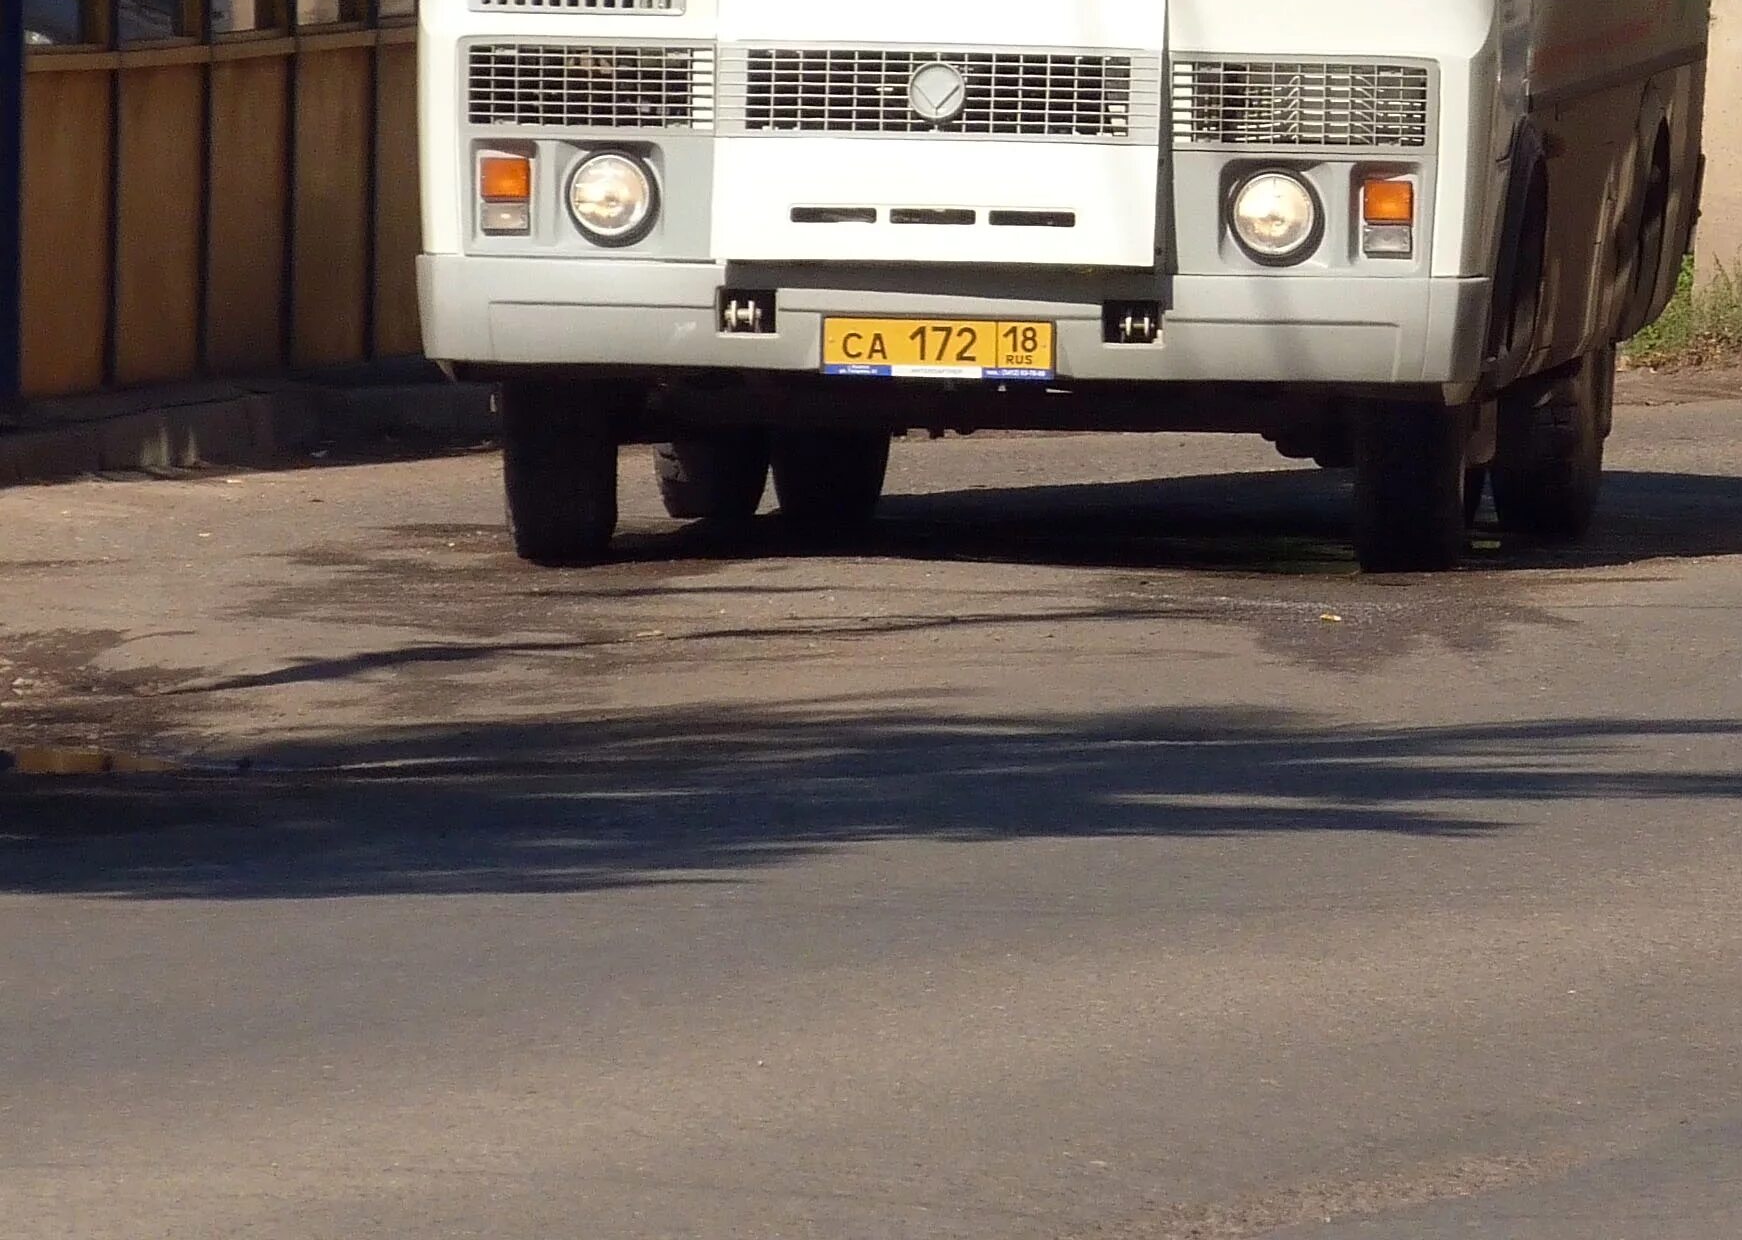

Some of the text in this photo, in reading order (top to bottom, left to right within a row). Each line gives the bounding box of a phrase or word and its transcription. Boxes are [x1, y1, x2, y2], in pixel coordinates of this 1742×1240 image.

[842, 326, 1038, 361] СА 172 18
[1006, 354, 1033, 365] RUS
